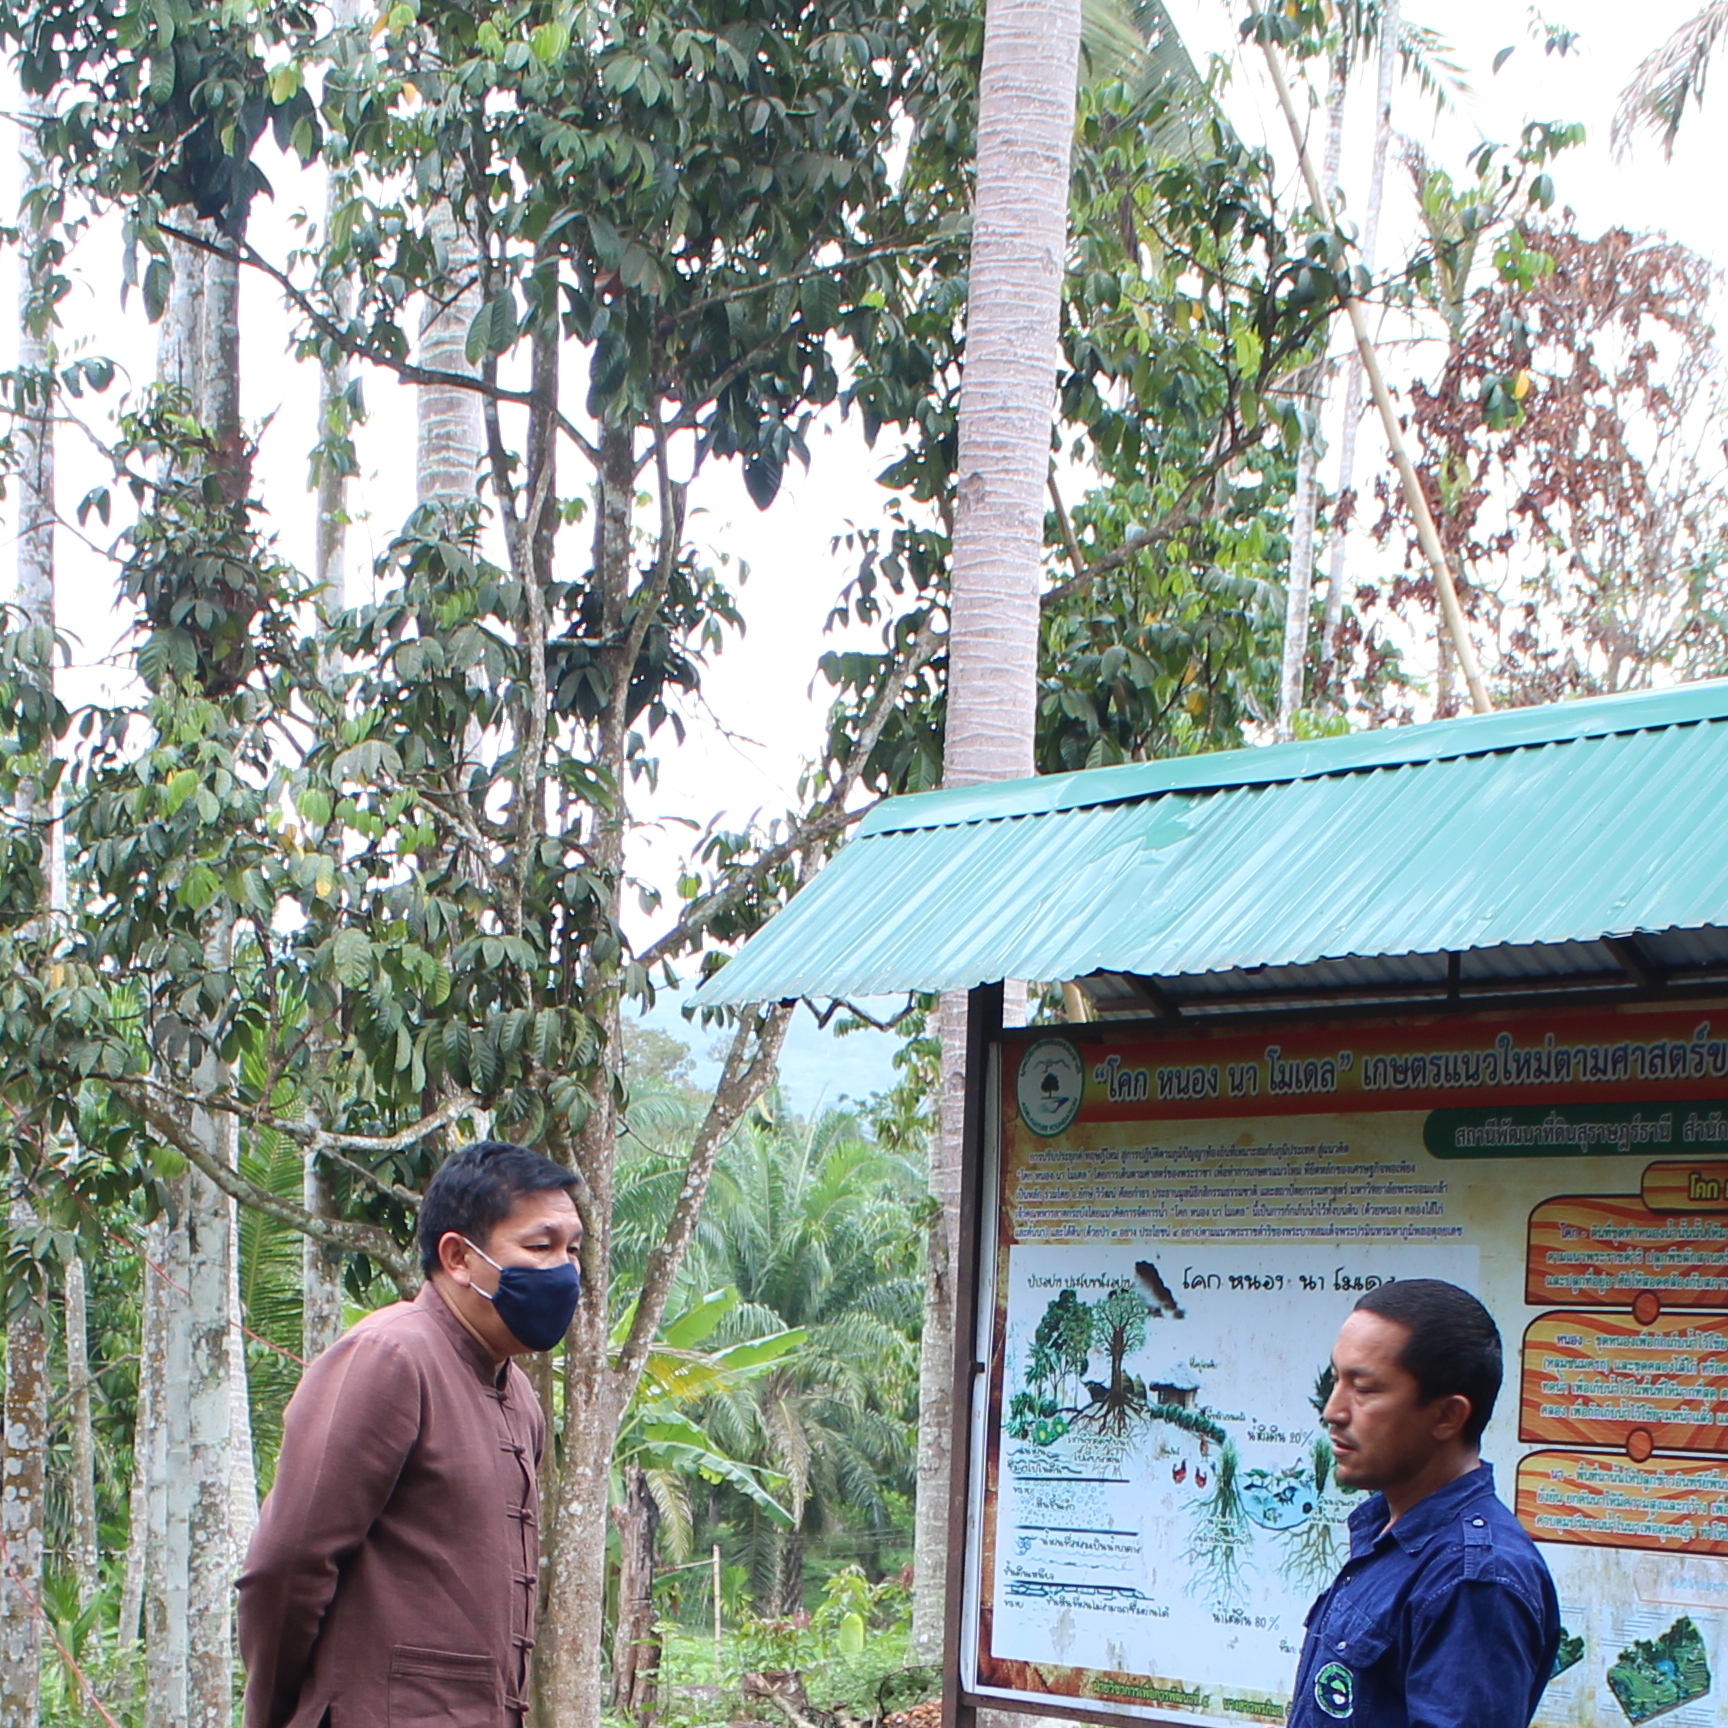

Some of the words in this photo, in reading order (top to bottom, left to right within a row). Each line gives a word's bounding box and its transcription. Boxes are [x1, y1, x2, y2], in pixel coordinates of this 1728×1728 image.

[1095, 1055, 1148, 1101] “โคก
[1156, 1066, 1219, 1098] หนอง
[1228, 1063, 1259, 1097] นา
[1265, 1045, 1353, 1094] โมเดล”
[1454, 1111, 1672, 1152] สถานีพัฒนาที่ดินสุราษฎร์ธานี
[1689, 1172, 1719, 1200] โคก
[1333, 1266, 1396, 1291] โมเด
